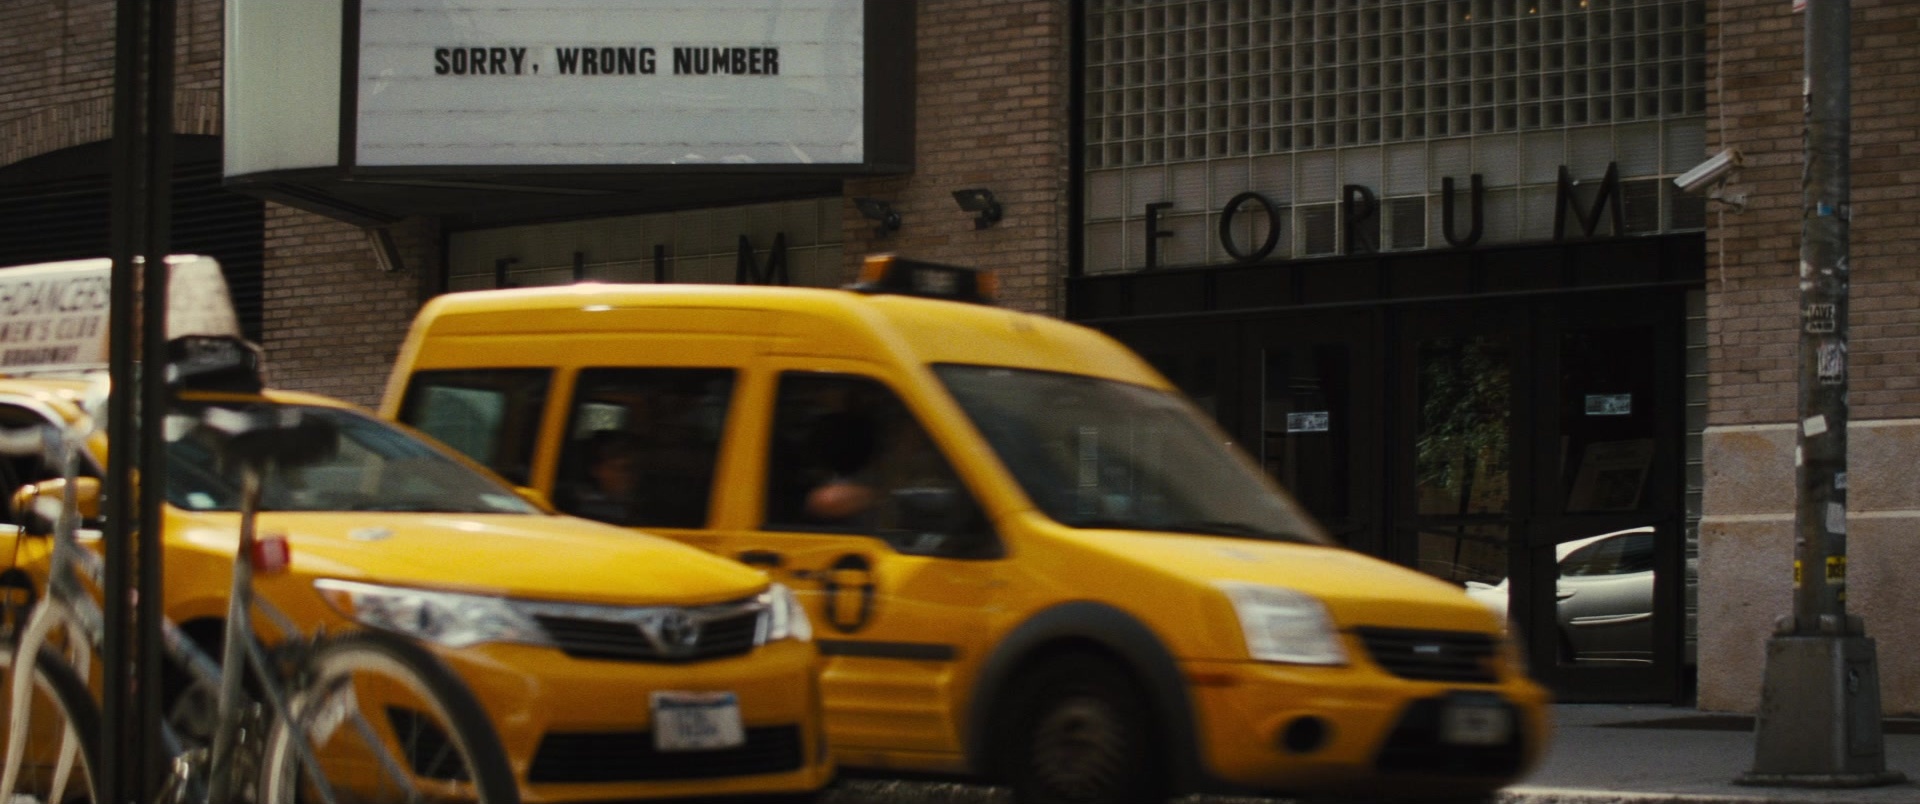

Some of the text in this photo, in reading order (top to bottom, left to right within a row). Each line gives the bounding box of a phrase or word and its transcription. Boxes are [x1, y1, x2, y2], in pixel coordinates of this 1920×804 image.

[434, 47, 780, 75] SORRY, WRONG NUMBER
[1145, 161, 1624, 270] FORUM
